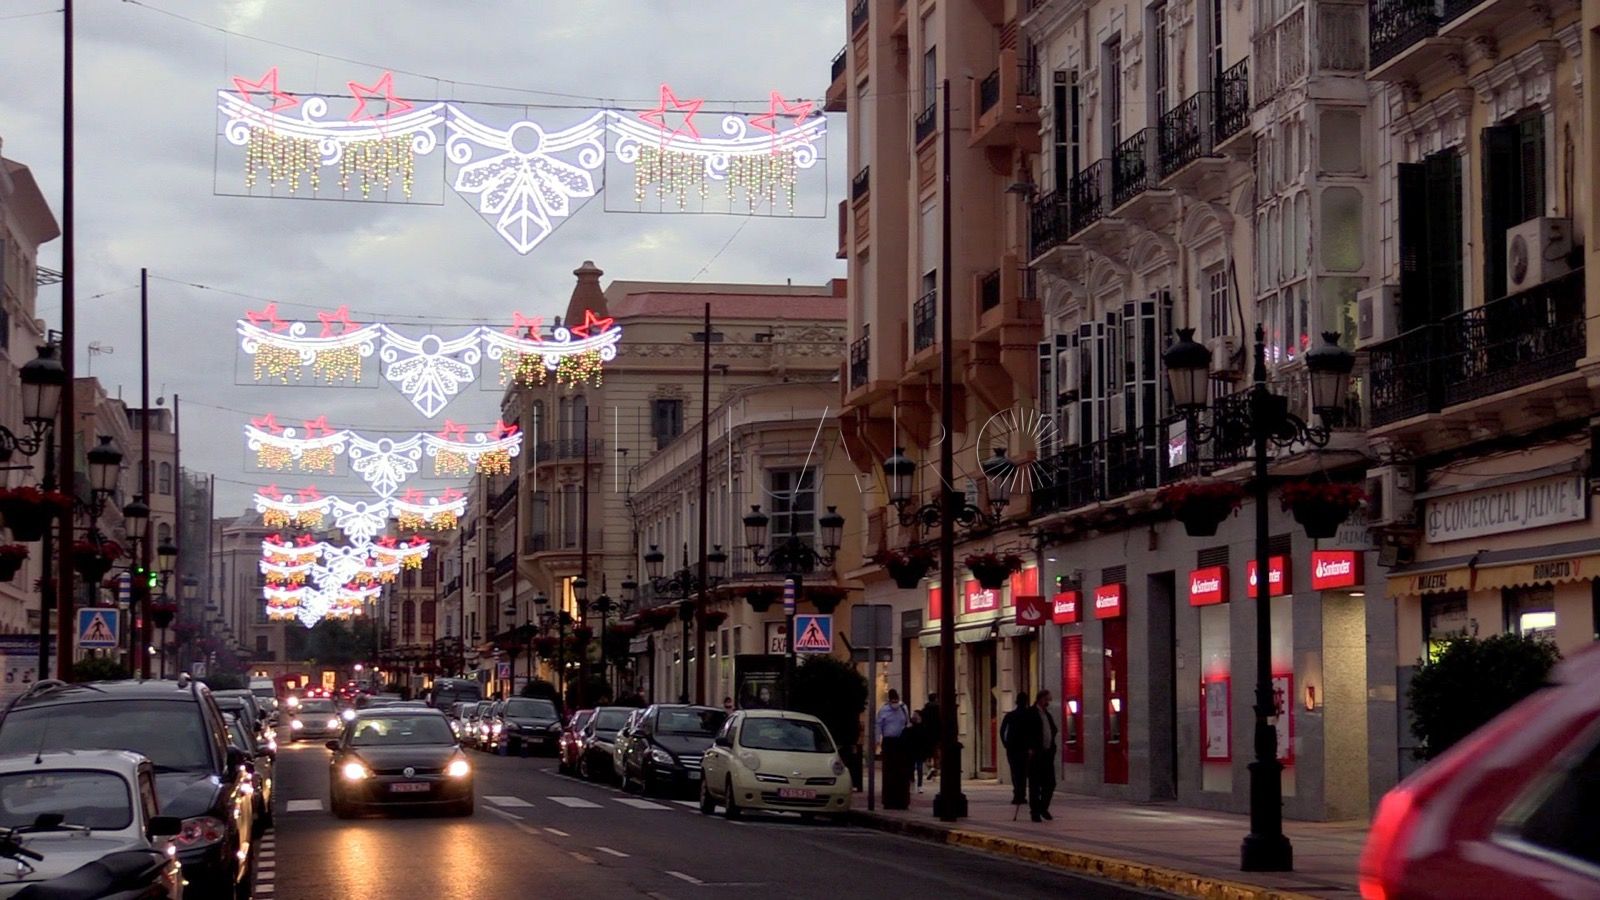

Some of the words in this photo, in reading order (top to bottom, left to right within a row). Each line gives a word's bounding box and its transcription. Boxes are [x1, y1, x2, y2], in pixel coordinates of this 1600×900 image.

[1444, 491, 1519, 532] COMERCIAL
[1521, 481, 1568, 525] JAIME
[1322, 559, 1350, 577] Santander
[1197, 578, 1219, 593] Santander
